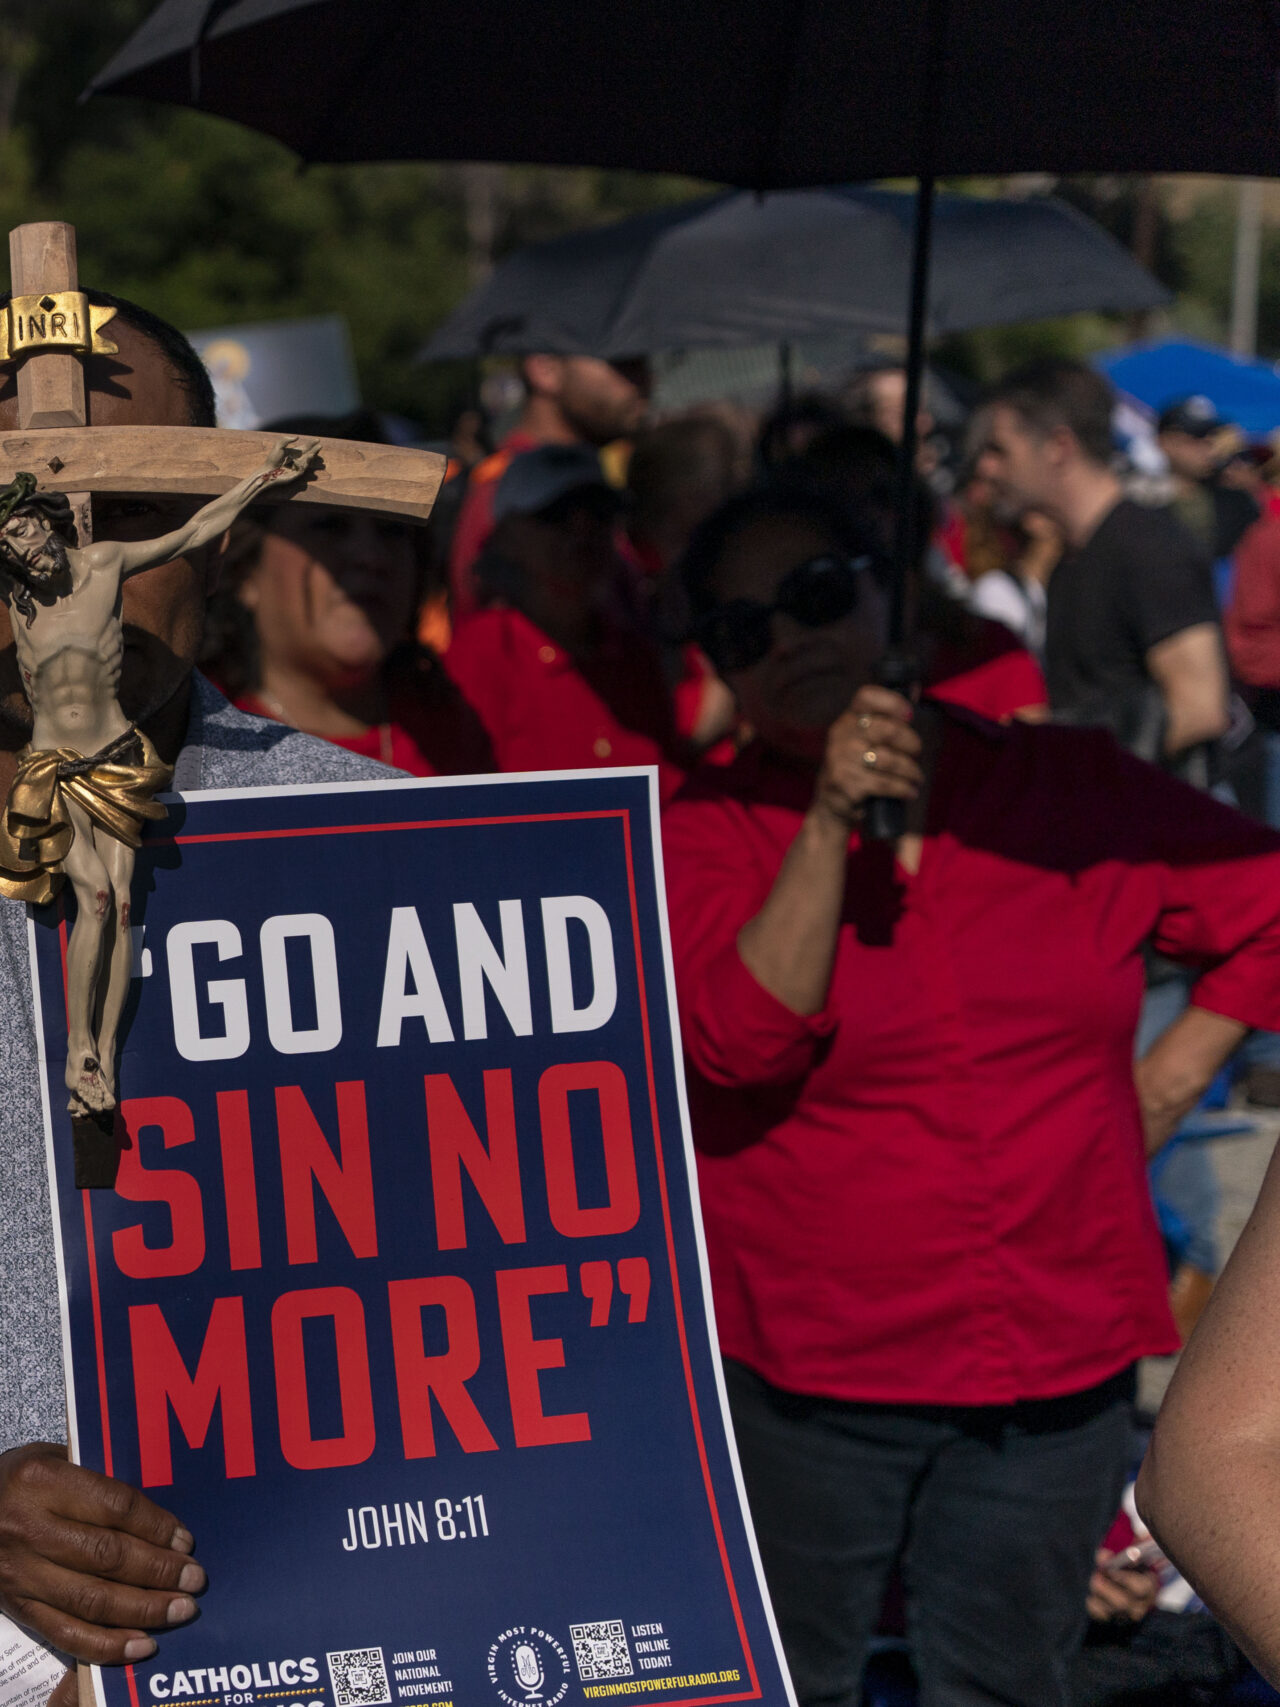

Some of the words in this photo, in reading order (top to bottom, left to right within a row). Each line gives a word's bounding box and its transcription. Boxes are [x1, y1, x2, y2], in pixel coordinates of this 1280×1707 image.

[18, 312, 80, 341] INRI
[376, 895, 618, 1047] AND
[112, 1079, 379, 1279] SIN
[425, 1060, 642, 1251] NO
[342, 1500, 429, 1551] JOHN
[435, 1493, 490, 1540] 8:11
[631, 1622, 663, 1637] LISTEN
[392, 1651, 415, 1664] JOIN
[416, 1648, 437, 1662] OUR
[488, 1643, 499, 1684] VIRGIN
[498, 1626, 525, 1643] MOST
[530, 1627, 571, 1674] POWERFUL
[635, 1638, 670, 1654] ONLINE
[8, 1661, 16, 1671] of
[16, 1648, 36, 1666] mercy
[8, 1667, 27, 1681] world
[27, 1658, 40, 1670] and
[638, 1655, 673, 1670] TODAY!
[23, 1688, 31, 1697] of
[31, 1678, 50, 1693] mercy
[50, 1671, 60, 1682] for
[149, 1657, 320, 1699] CATHOLICS
[394, 1665, 441, 1681] NATIONAL
[583, 1669, 740, 1699] VIRGINMOSTPOWERFULRADIO.ORG
[223, 1692, 254, 1706] FOR
[397, 1680, 454, 1698] MOVEMENT!
[546, 1682, 569, 1707] RADIO
